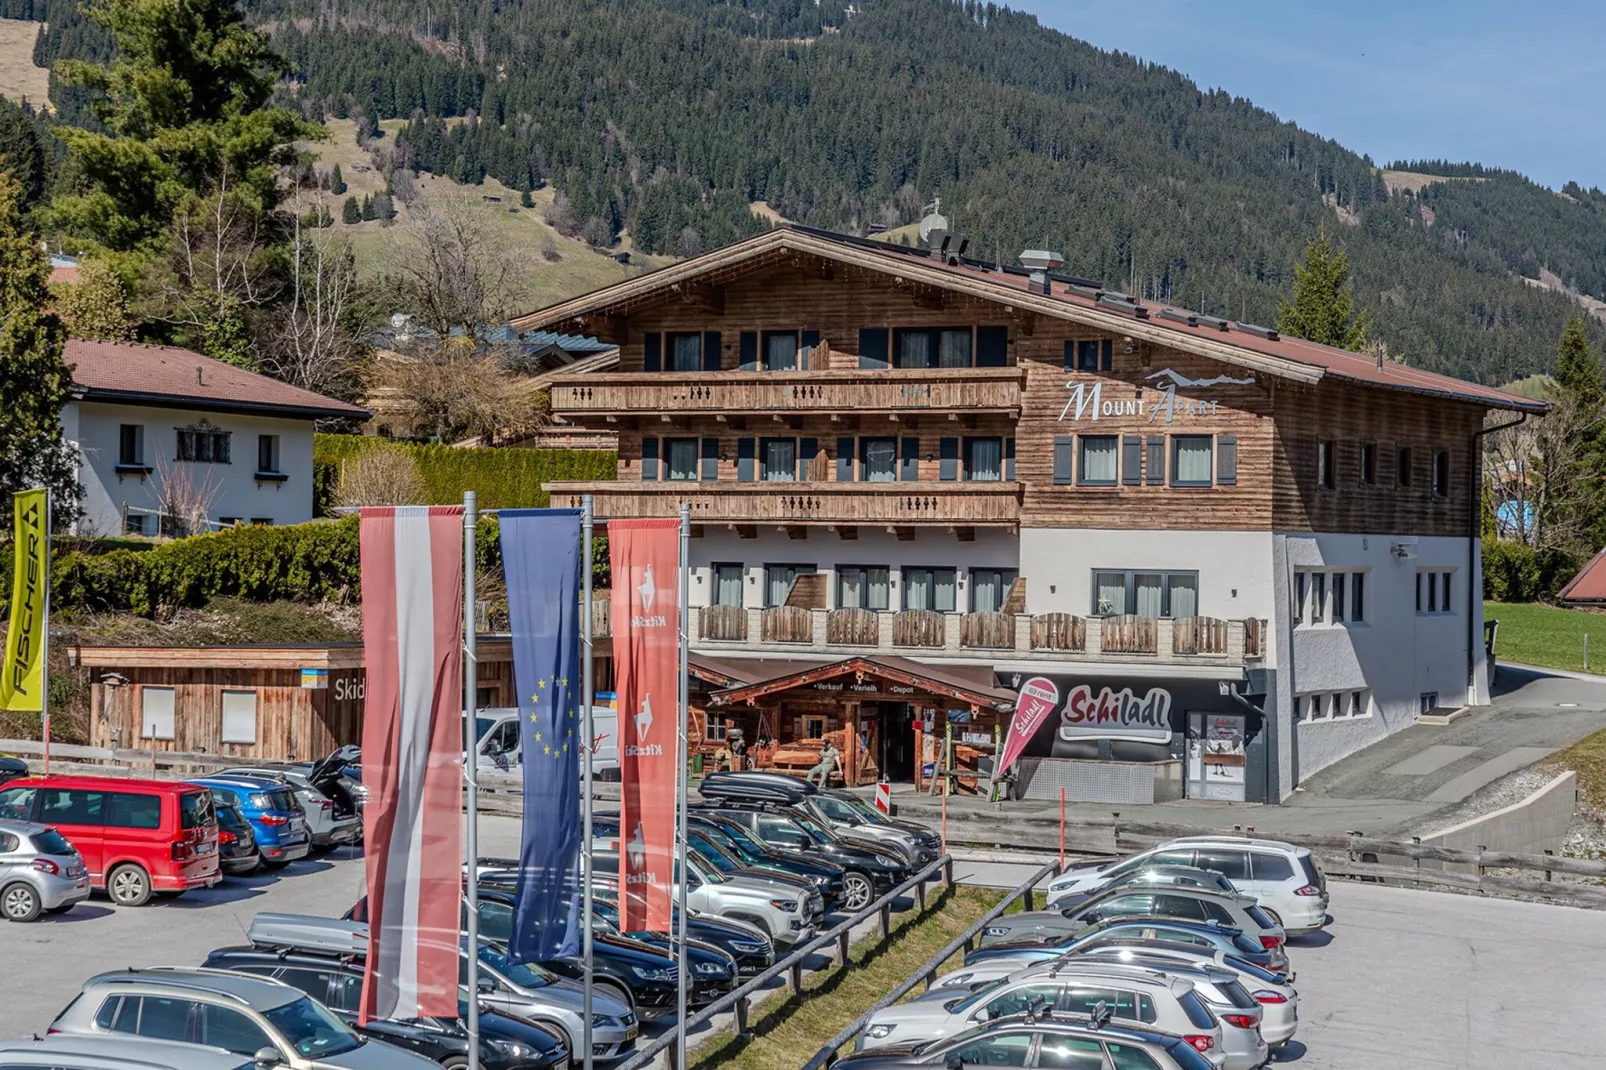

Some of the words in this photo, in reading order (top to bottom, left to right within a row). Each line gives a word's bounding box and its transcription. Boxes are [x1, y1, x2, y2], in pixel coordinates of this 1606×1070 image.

[13, 532, 39, 696] FISCHER
[335, 677, 365, 701] Skid
[817, 683, 843, 691] Verkauf
[853, 684, 877, 692] Verleih
[893, 686, 914, 694] Depot
[1015, 699, 1041, 734] Schiladl
[1064, 689, 1166, 728] Schiladl
